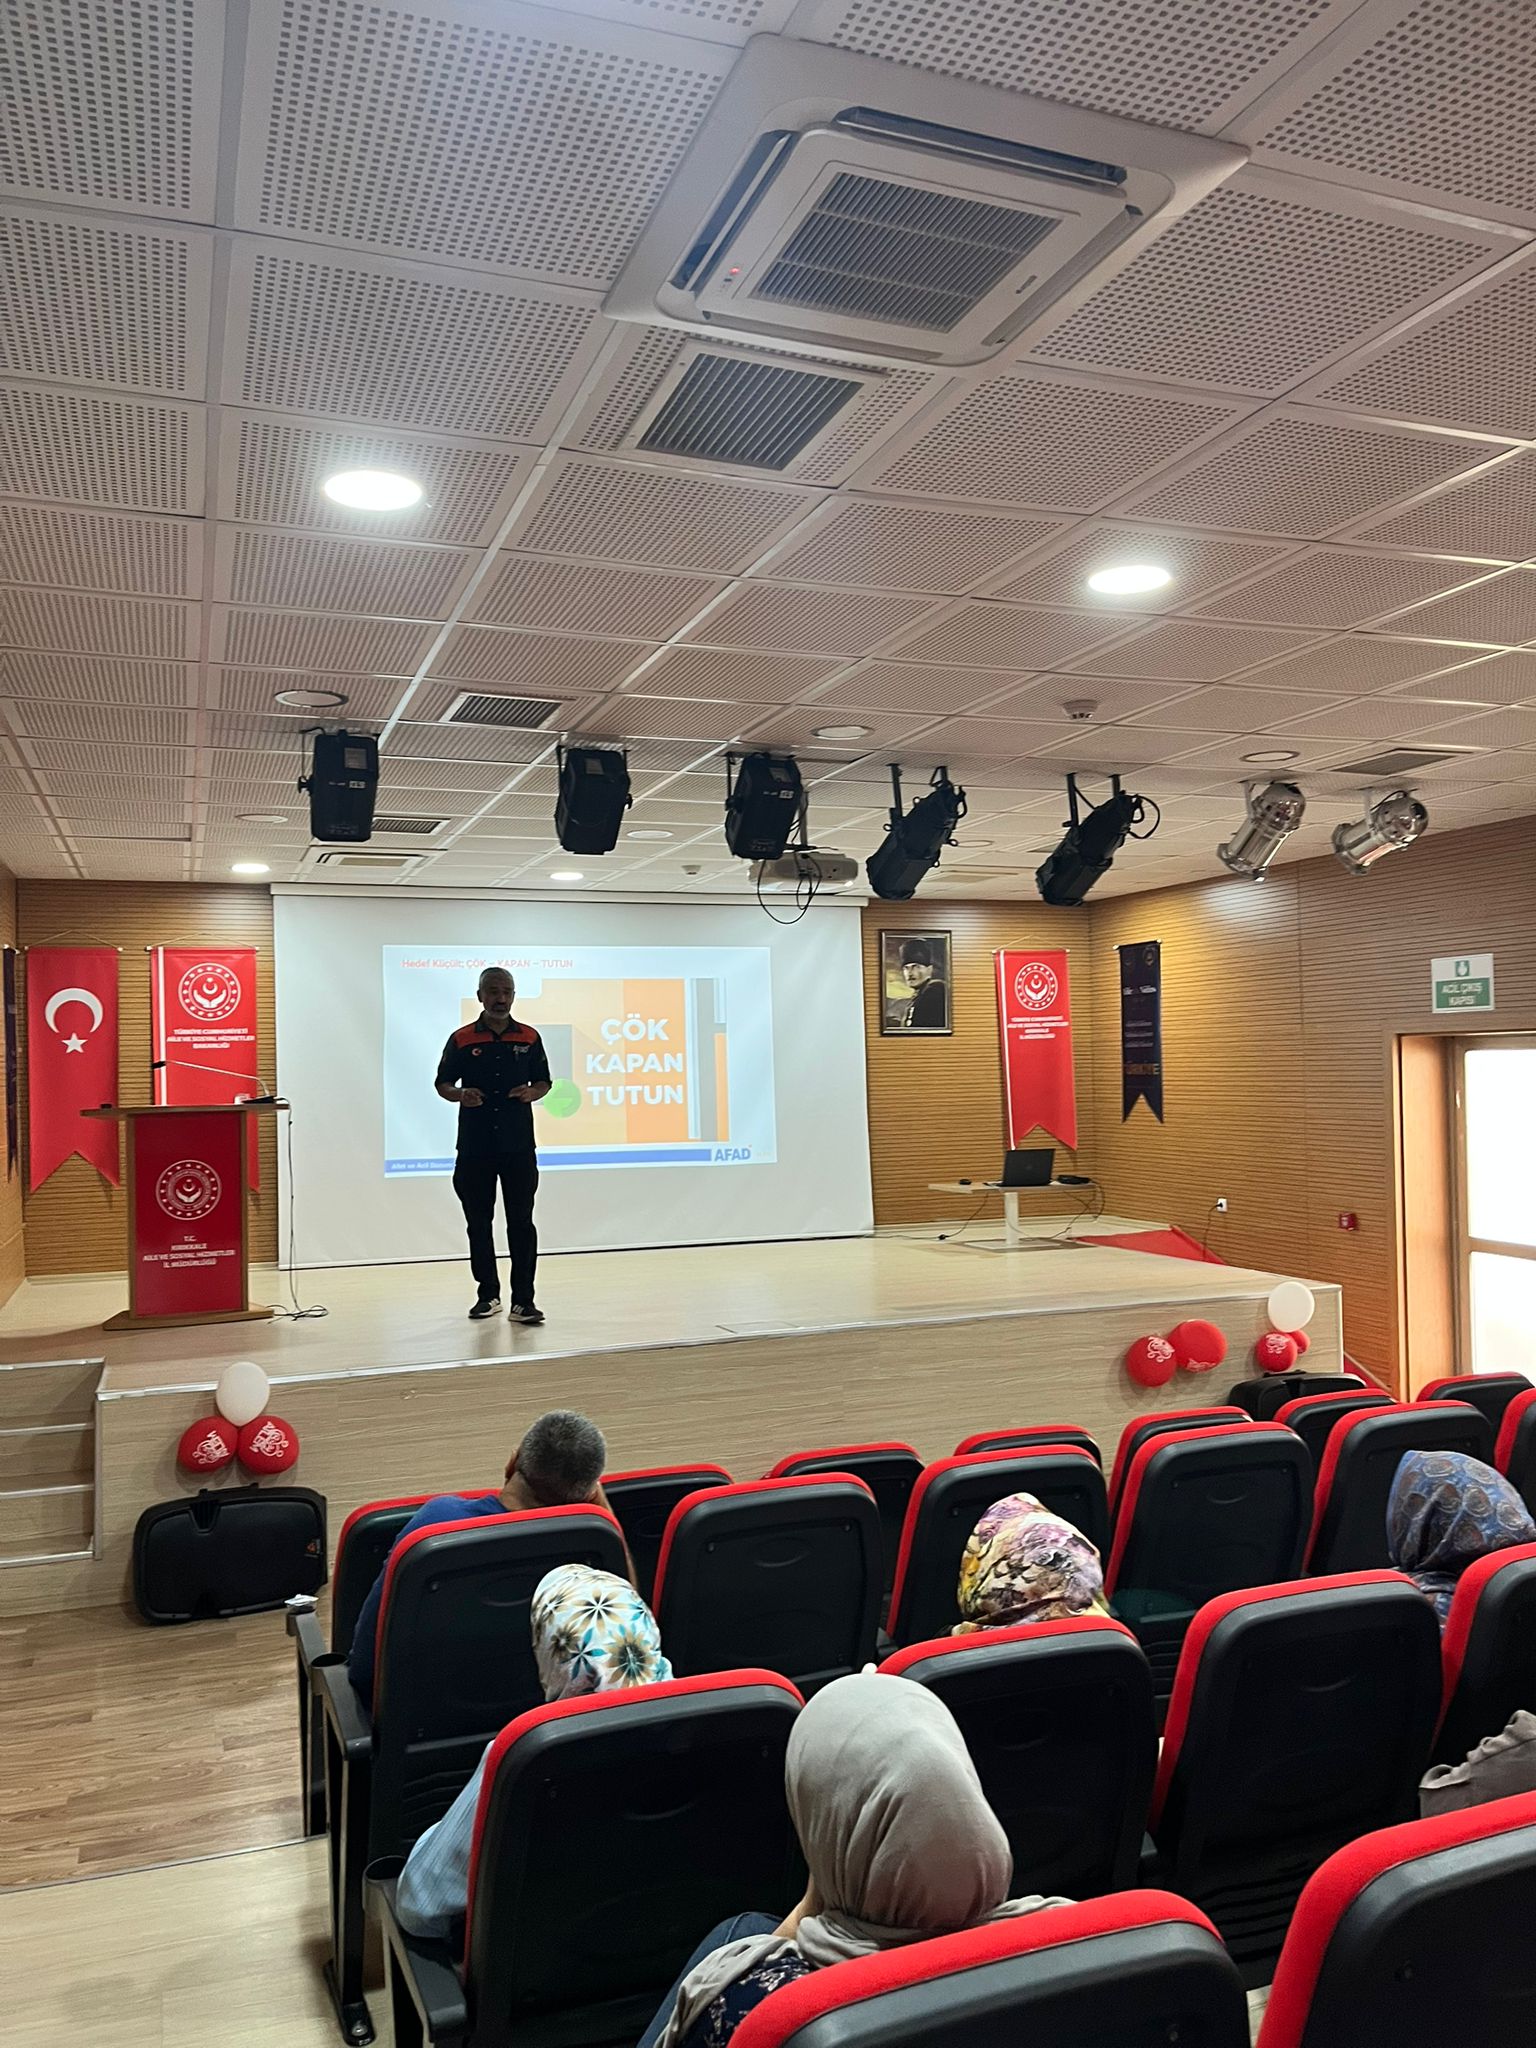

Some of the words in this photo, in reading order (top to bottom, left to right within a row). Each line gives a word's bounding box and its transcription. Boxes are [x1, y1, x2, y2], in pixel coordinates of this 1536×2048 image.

[402, 959, 430, 968] Hedef
[466, 958, 486, 969] ÇÖK
[497, 959, 530, 968] KAPAN
[541, 959, 574, 968] TUTUN
[600, 1013, 669, 1045] ÇÖK
[586, 1052, 684, 1074] KAPAN
[586, 1084, 684, 1106] TUTUN
[714, 1147, 752, 1162] AFAD
